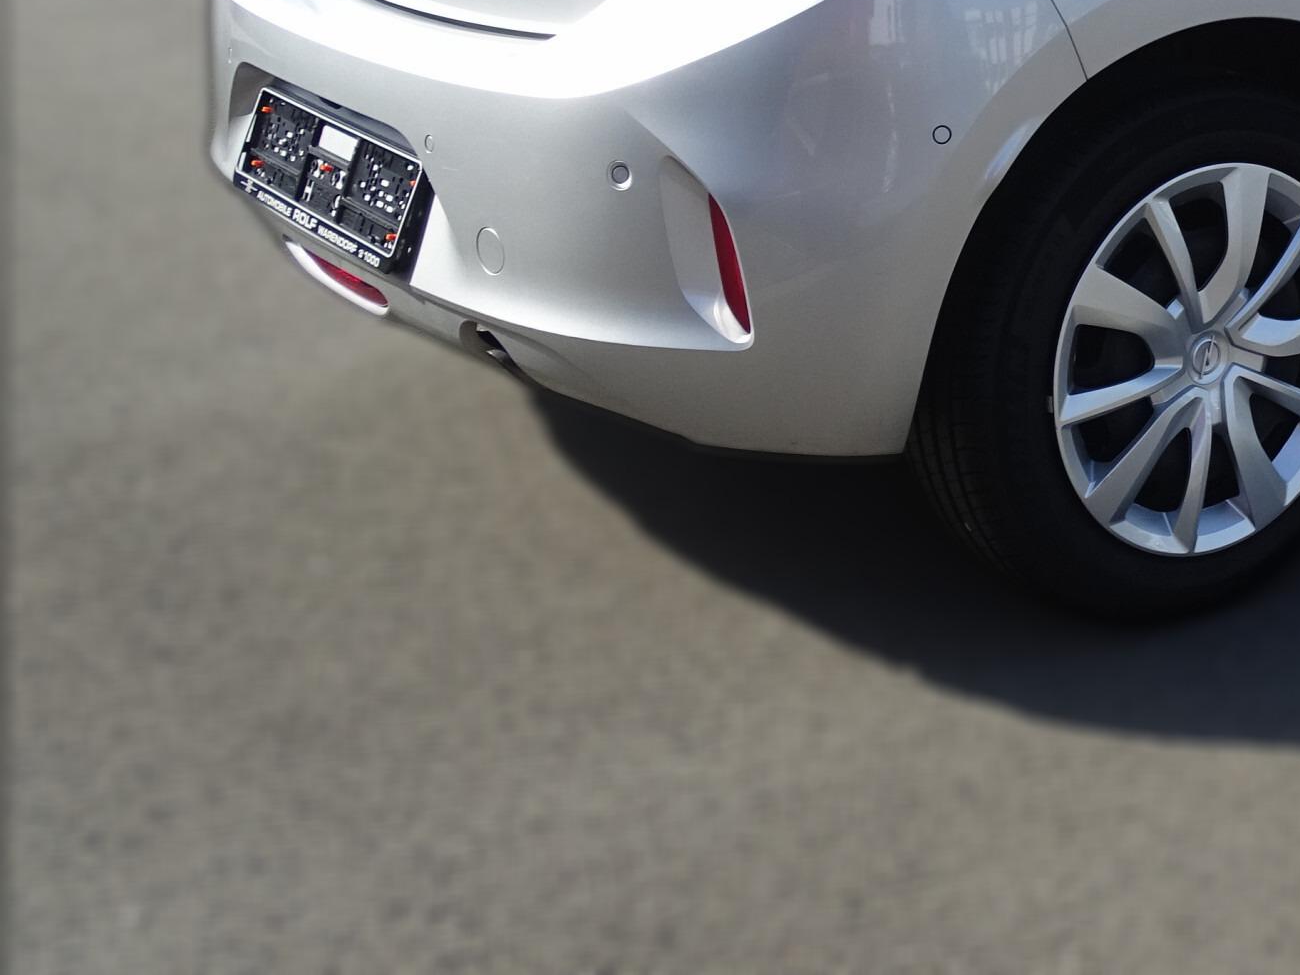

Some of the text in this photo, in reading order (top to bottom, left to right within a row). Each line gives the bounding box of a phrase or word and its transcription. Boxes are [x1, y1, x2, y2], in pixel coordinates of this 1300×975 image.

[256, 190, 292, 216] AUTOMOBILE
[292, 208, 318, 229] ROLF
[317, 225, 358, 253] WARENDORF
